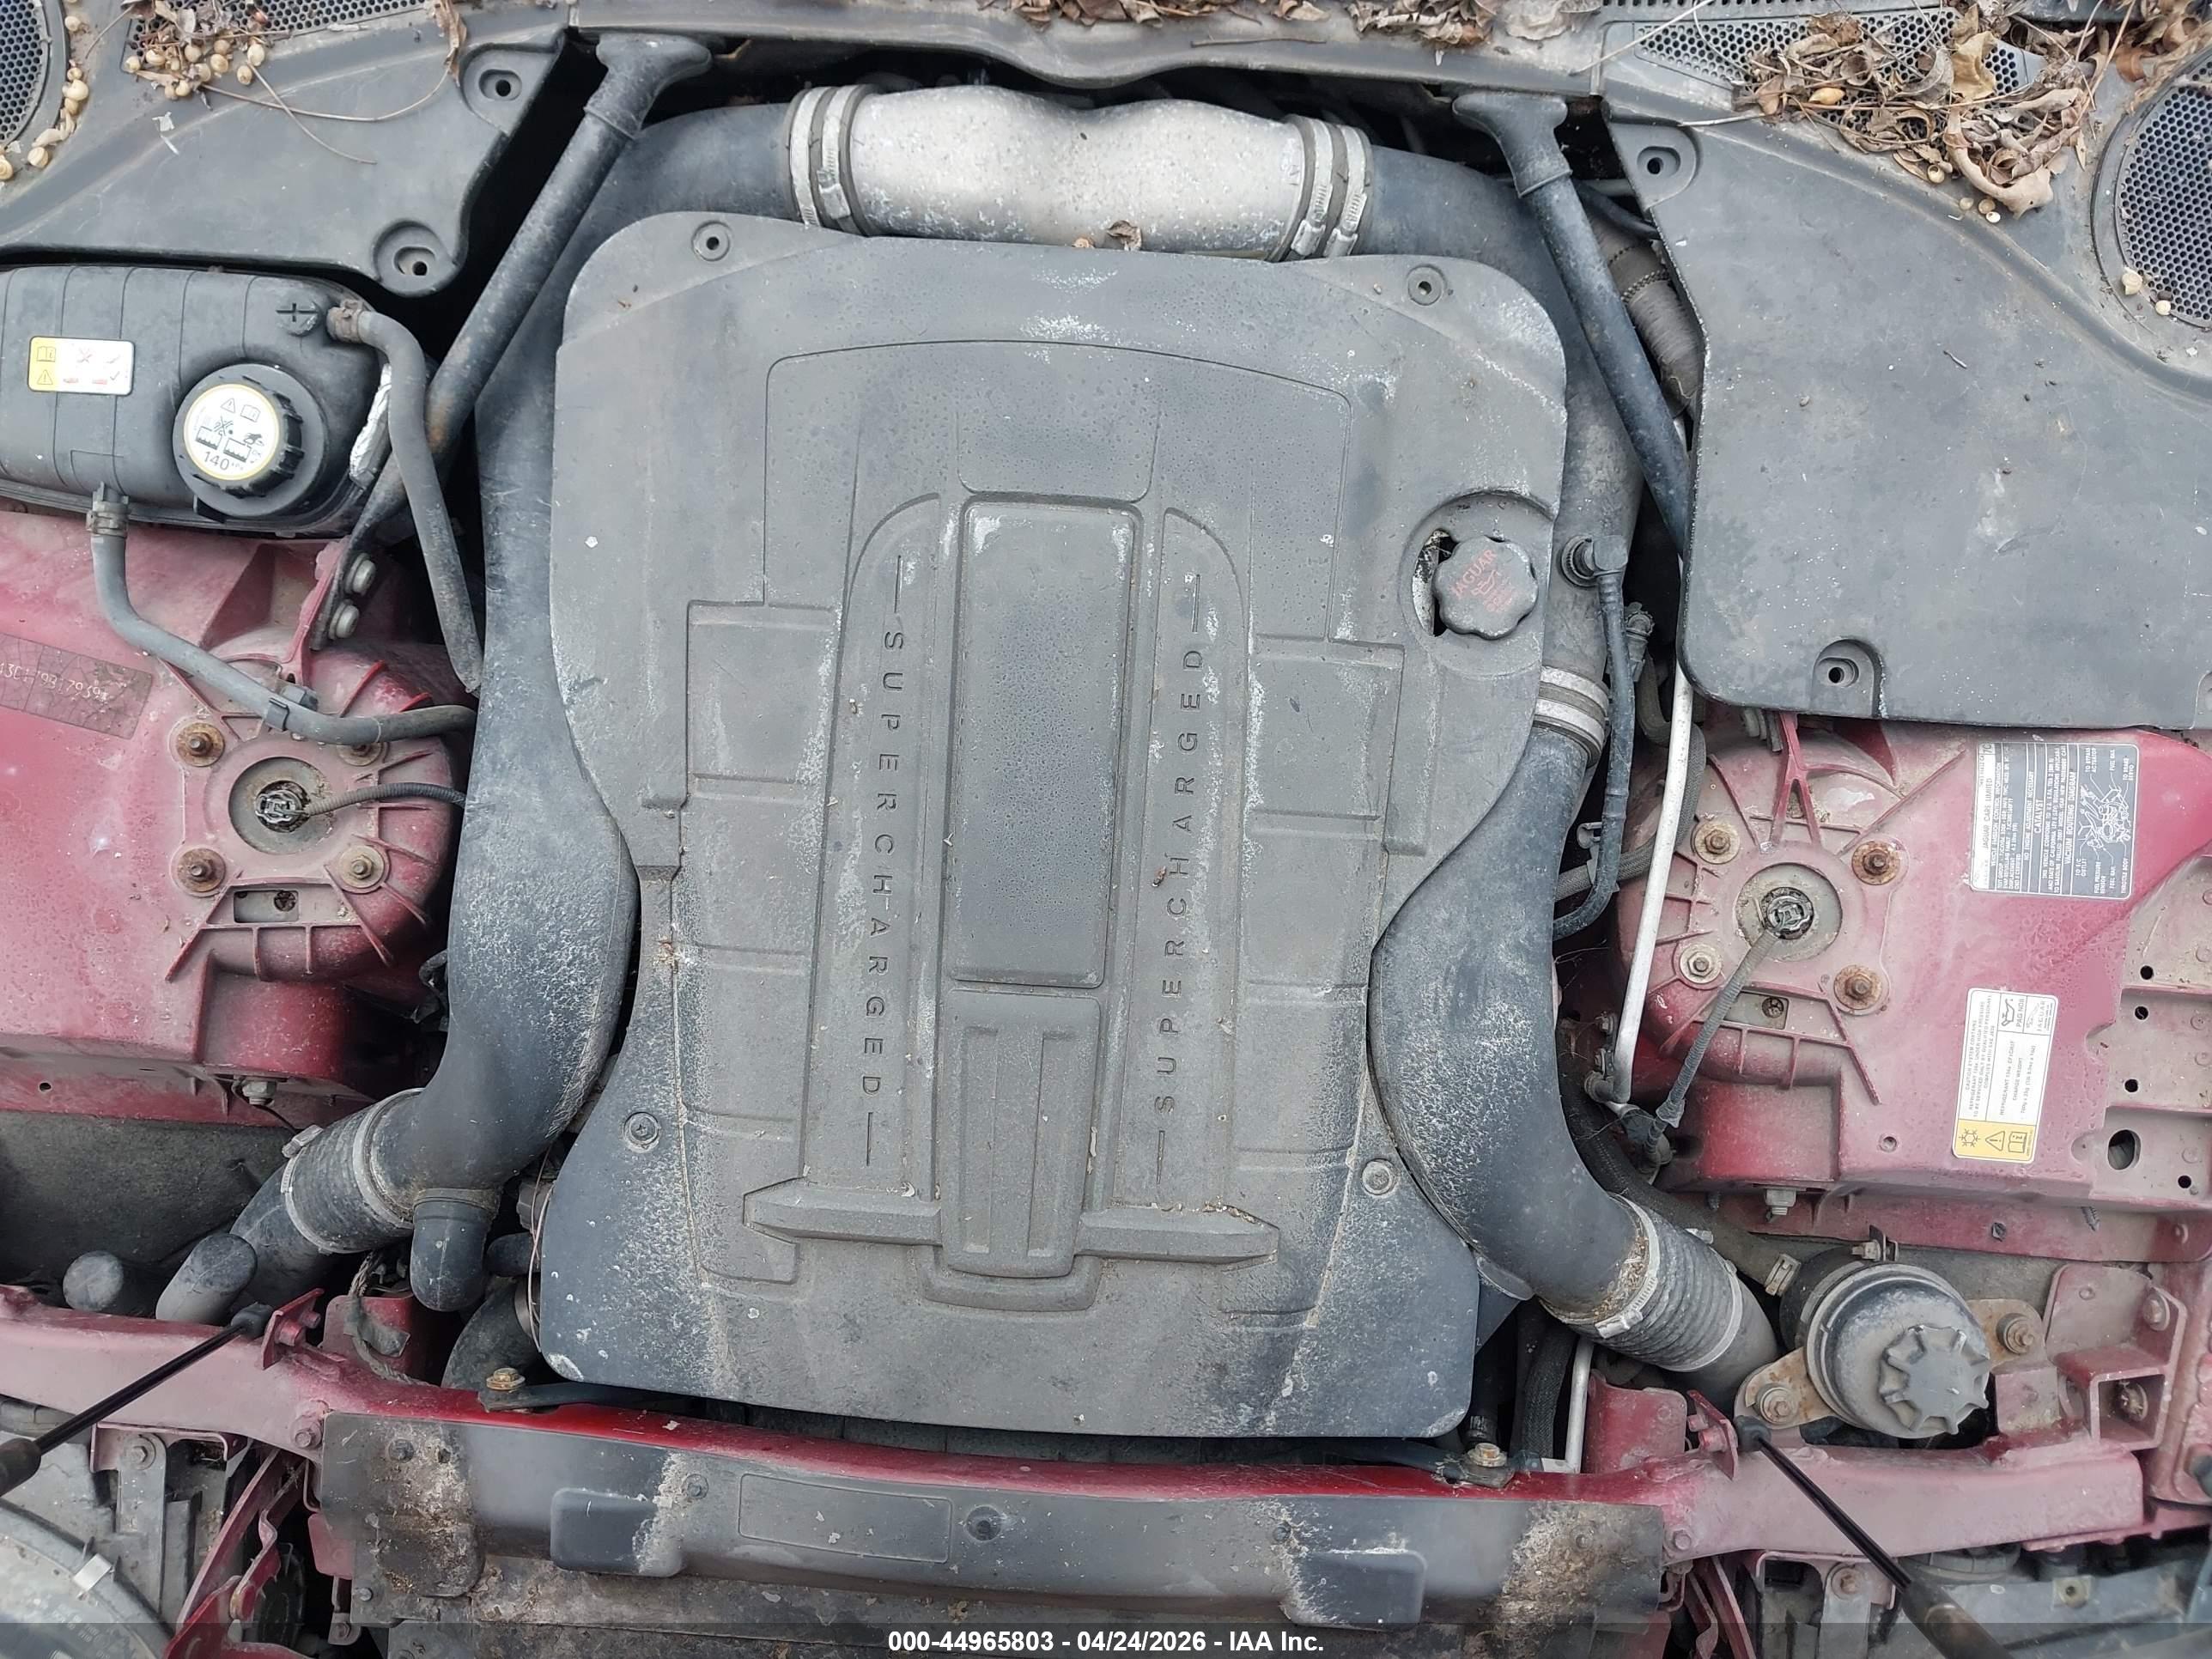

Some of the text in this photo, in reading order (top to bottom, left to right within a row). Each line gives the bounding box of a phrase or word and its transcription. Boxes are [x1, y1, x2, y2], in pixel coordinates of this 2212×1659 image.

[204, 451, 230, 471] 140
[1450, 549, 1497, 600] JAGUAR
[2033, 799, 2042, 833] CATALYST
[861, 630, 904, 1095] SUPERCHARGED
[1154, 648, 1204, 1114] SUPERCHARGED
[2036, 1000, 2045, 1030] JAGUAR
